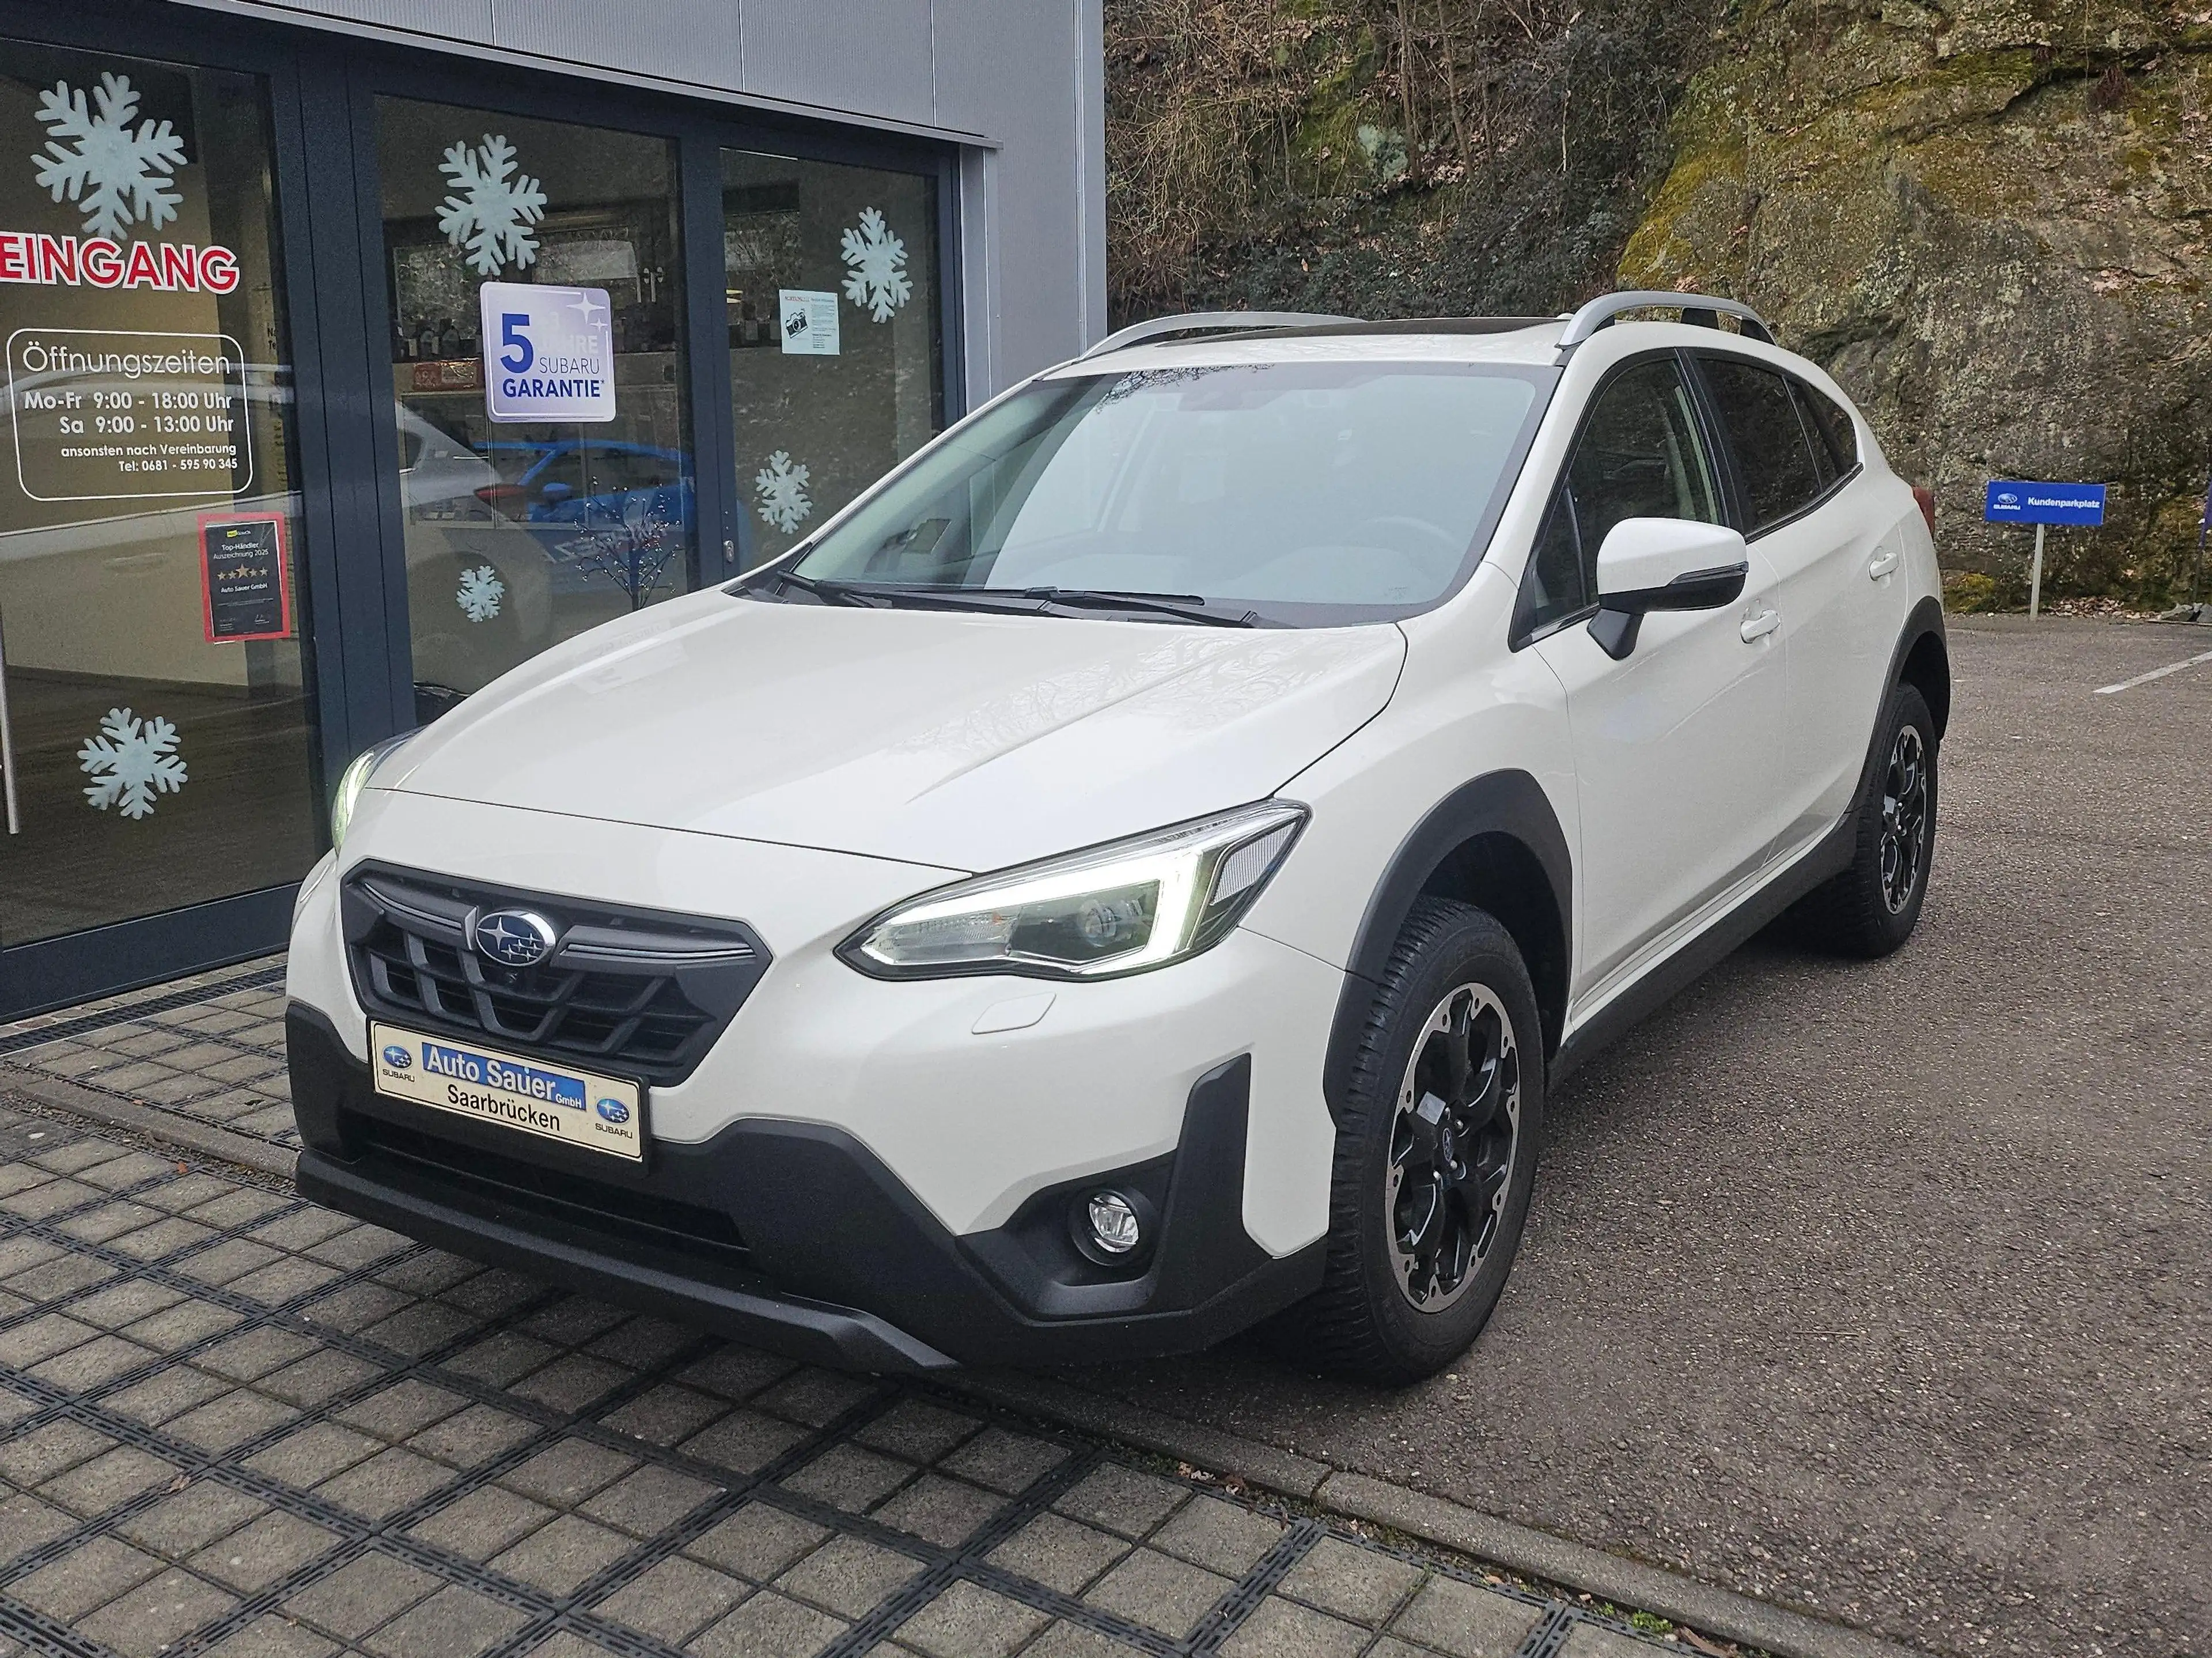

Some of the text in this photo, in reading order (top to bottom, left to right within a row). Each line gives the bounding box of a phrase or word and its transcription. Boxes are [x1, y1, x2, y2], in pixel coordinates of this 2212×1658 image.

[0, 232, 240, 294] EINGANG
[501, 313, 534, 373] 5
[22, 341, 230, 379] Öffnungszeiten
[539, 357, 600, 374] SUBARU
[24, 392, 82, 410] Mo-Fr
[93, 392, 132, 410] 9:00
[151, 392, 199, 409] 18:00
[203, 392, 232, 409] Uhr
[59, 416, 84, 434] Sa
[95, 415, 134, 434] 9:00
[154, 415, 200, 433] 13:00
[206, 415, 234, 433] Uhr
[61, 443, 237, 457] ansonsten nach Vereinbarung
[119, 460, 139, 472] Tel:
[141, 460, 168, 471] 0681
[180, 459, 200, 470] 595
[202, 459, 216, 470] 90
[218, 458, 238, 469] 345
[2028, 497, 2100, 509] Kundenparkplatz
[382, 1069, 415, 1082] SUBARU
[427, 1046, 582, 1108] Auto Sauer GmbH
[447, 1084, 560, 1131] Saarbrücken
[594, 1122, 633, 1139] SUBARU
